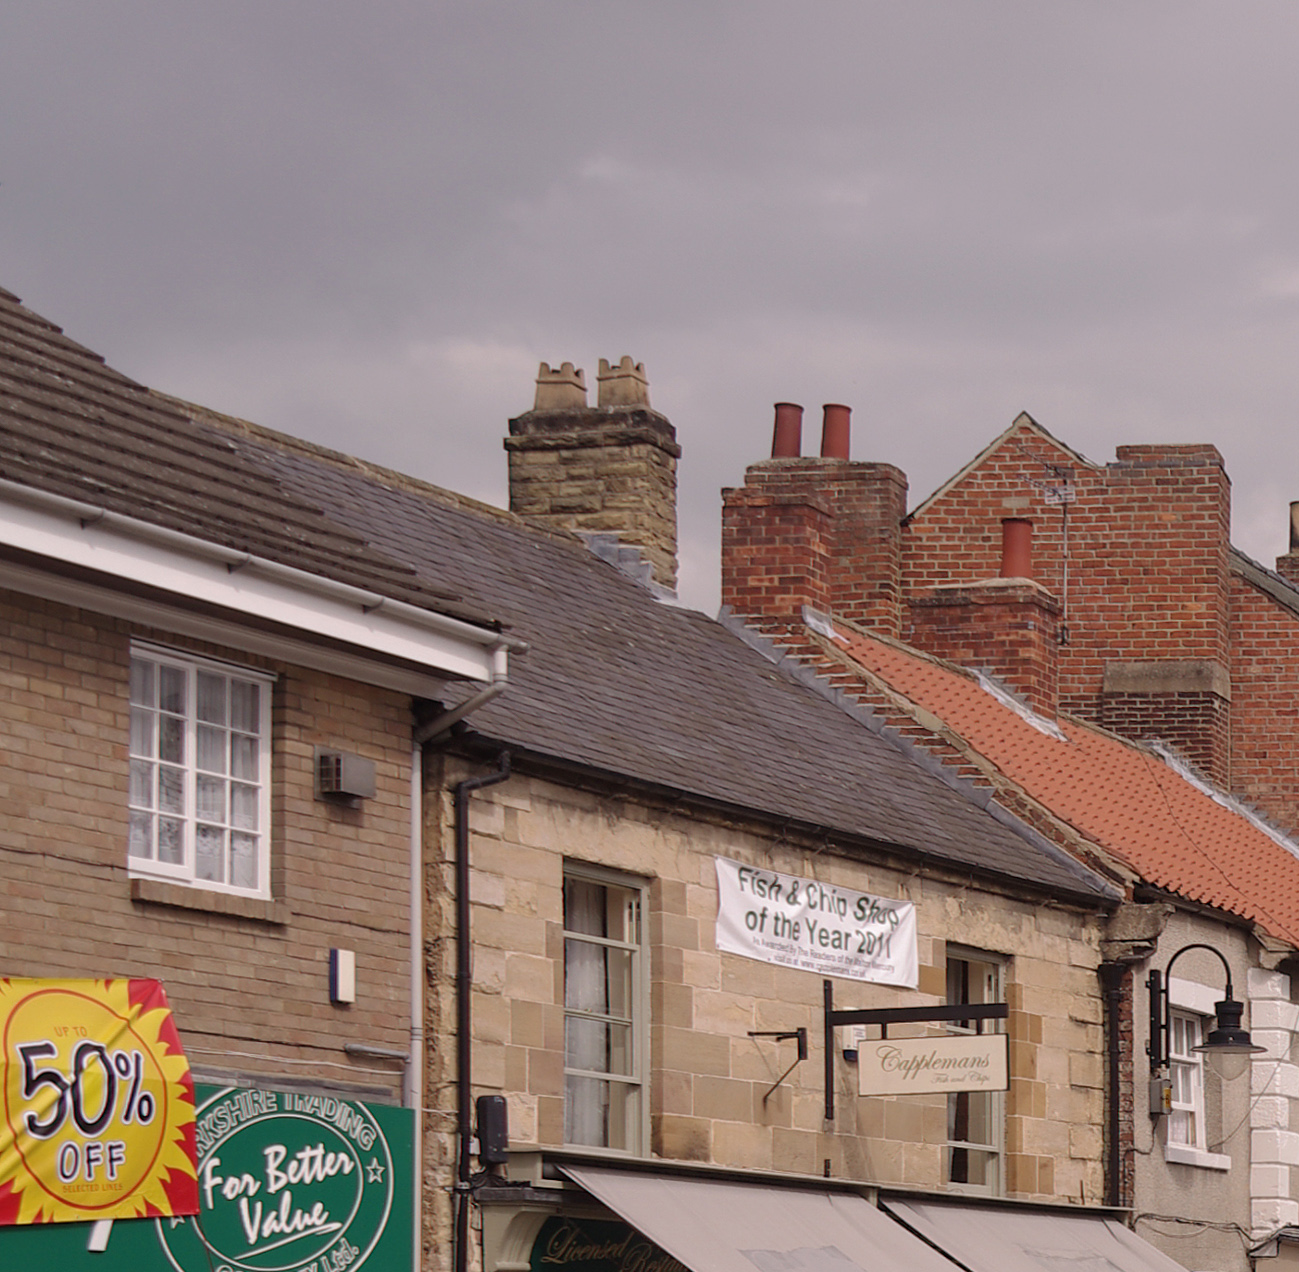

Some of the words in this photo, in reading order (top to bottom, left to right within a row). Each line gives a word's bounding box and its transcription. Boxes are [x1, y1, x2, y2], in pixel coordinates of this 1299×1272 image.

[738, 866, 783, 902] Fish
[786, 880, 801, 906] &
[806, 882, 847, 921] Chip
[854, 896, 899, 932] Shop
[745, 907, 768, 933] of
[773, 911, 800, 941] the
[805, 917, 852, 951] Year
[855, 930, 893, 959] 2011
[54, 1026, 68, 1038] UP
[73, 1026, 87, 1037] TO
[876, 1045, 990, 1080] Capplemans
[16, 1040, 156, 1140] 50%
[58, 1141, 126, 1183] OFF
[204, 1157, 262, 1211] For
[264, 1142, 356, 1195] Better
[62, 1184, 99, 1194] SELECTED
[101, 1183, 124, 1193] LINES
[238, 1190, 330, 1246] Value
[540, 1226, 636, 1265] Licensed
